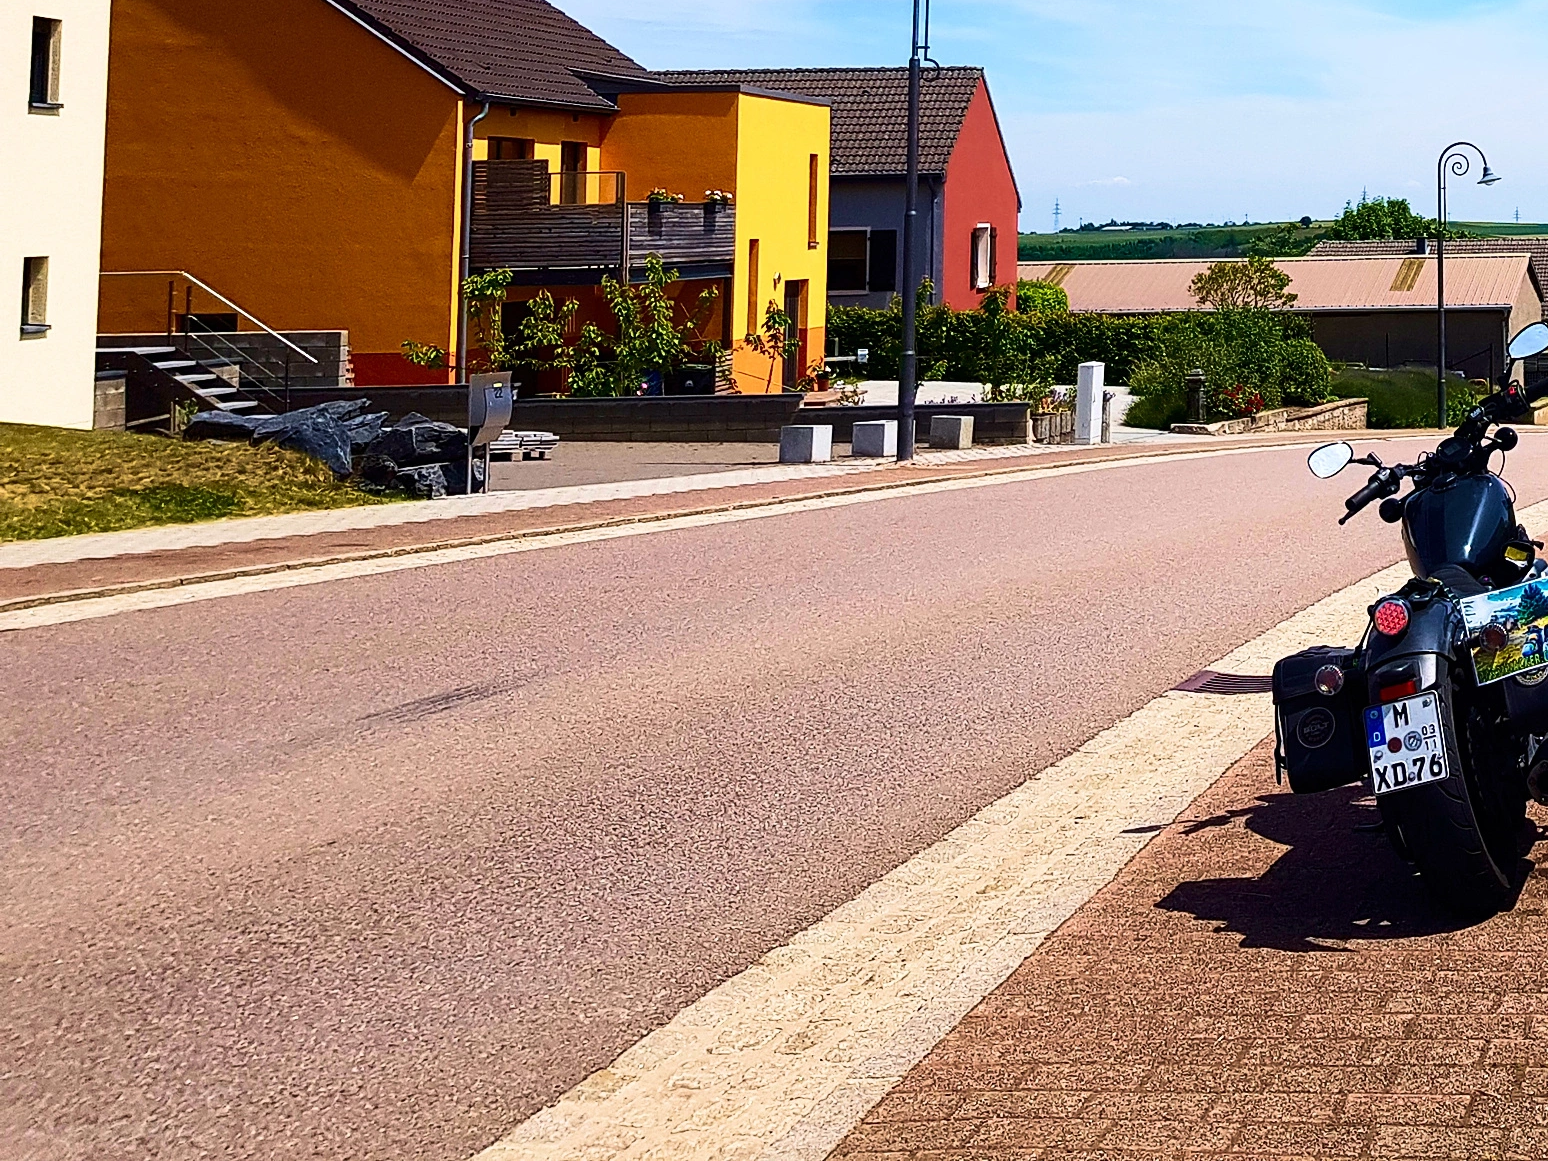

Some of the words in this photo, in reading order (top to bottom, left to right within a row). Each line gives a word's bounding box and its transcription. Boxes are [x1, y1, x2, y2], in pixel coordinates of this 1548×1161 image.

[1393, 702, 1409, 729] M
[1373, 731, 1381, 742] D
[1421, 723, 1436, 736] 03
[1375, 761, 1408, 792] XD
[1412, 753, 1443, 782] 76
